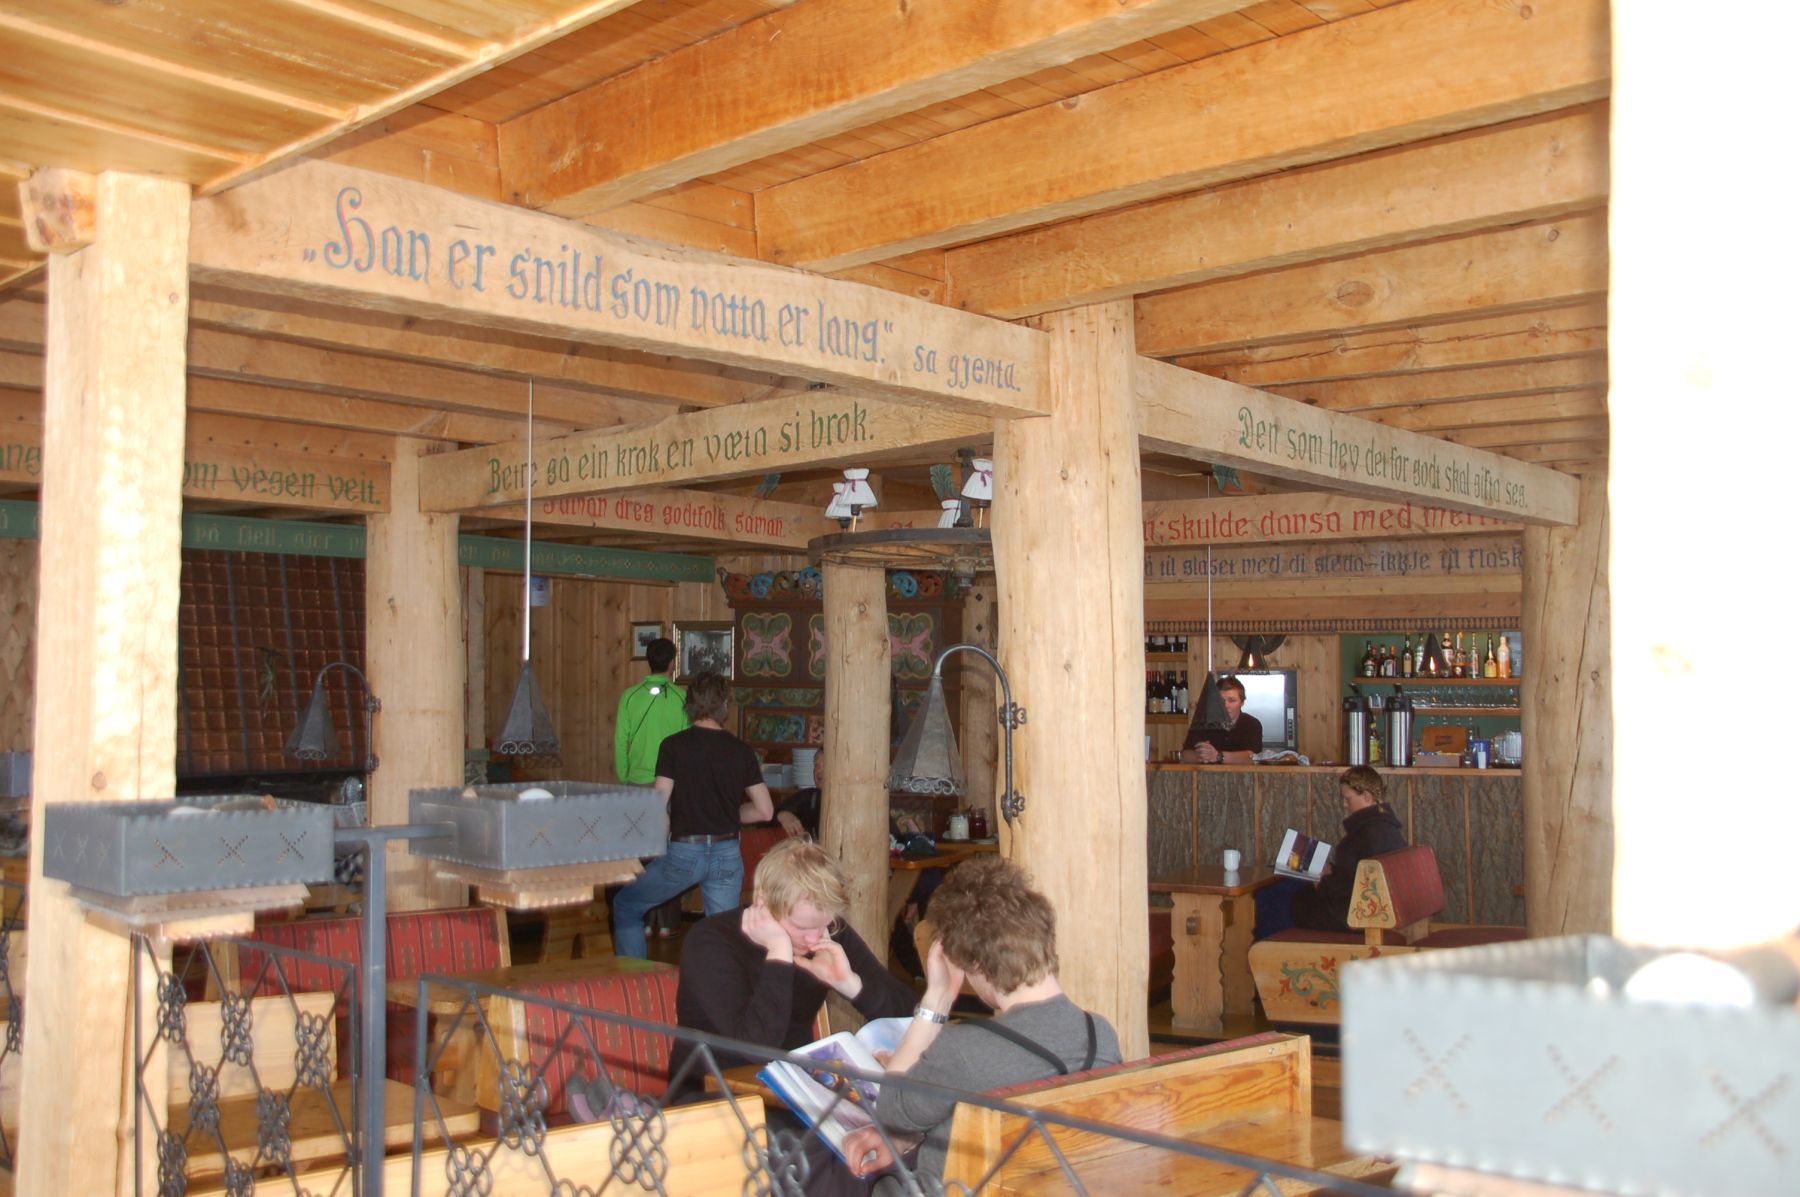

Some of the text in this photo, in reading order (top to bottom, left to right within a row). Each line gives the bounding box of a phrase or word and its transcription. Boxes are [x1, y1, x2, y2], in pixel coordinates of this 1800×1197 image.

[448, 239, 497, 292] er
[507, 245, 603, 313] snild
[611, 268, 681, 330] som
[690, 286, 769, 343] natta
[778, 303, 809, 347] er
[913, 345, 938, 374] sa
[947, 353, 1021, 392] gjenta.
[487, 457, 538, 495] Betre
[578, 444, 608, 480] ein
[667, 438, 694, 470] en
[704, 425, 767, 463] væta
[779, 411, 801, 453] si
[811, 401, 874, 449] brok.
[1238, 406, 1279, 454] Den
[1287, 428, 1322, 464] som
[1329, 428, 1359, 473] hev
[1365, 436, 1387, 479] det
[1390, 445, 1409, 482] for
[1413, 454, 1440, 490] godt
[1445, 459, 1470, 496] skal
[1474, 466, 1500, 503] gifta
[232, 464, 315, 497] vegen
[328, 468, 381, 505] veit.
[616, 495, 654, 523] dreg
[663, 503, 725, 530] godtfolk
[736, 511, 786, 538] saman.
[1168, 509, 1249, 541] skulde
[1261, 510, 1342, 537] dansa
[1353, 500, 1412, 533] med
[1468, 544, 1523, 570] flask
